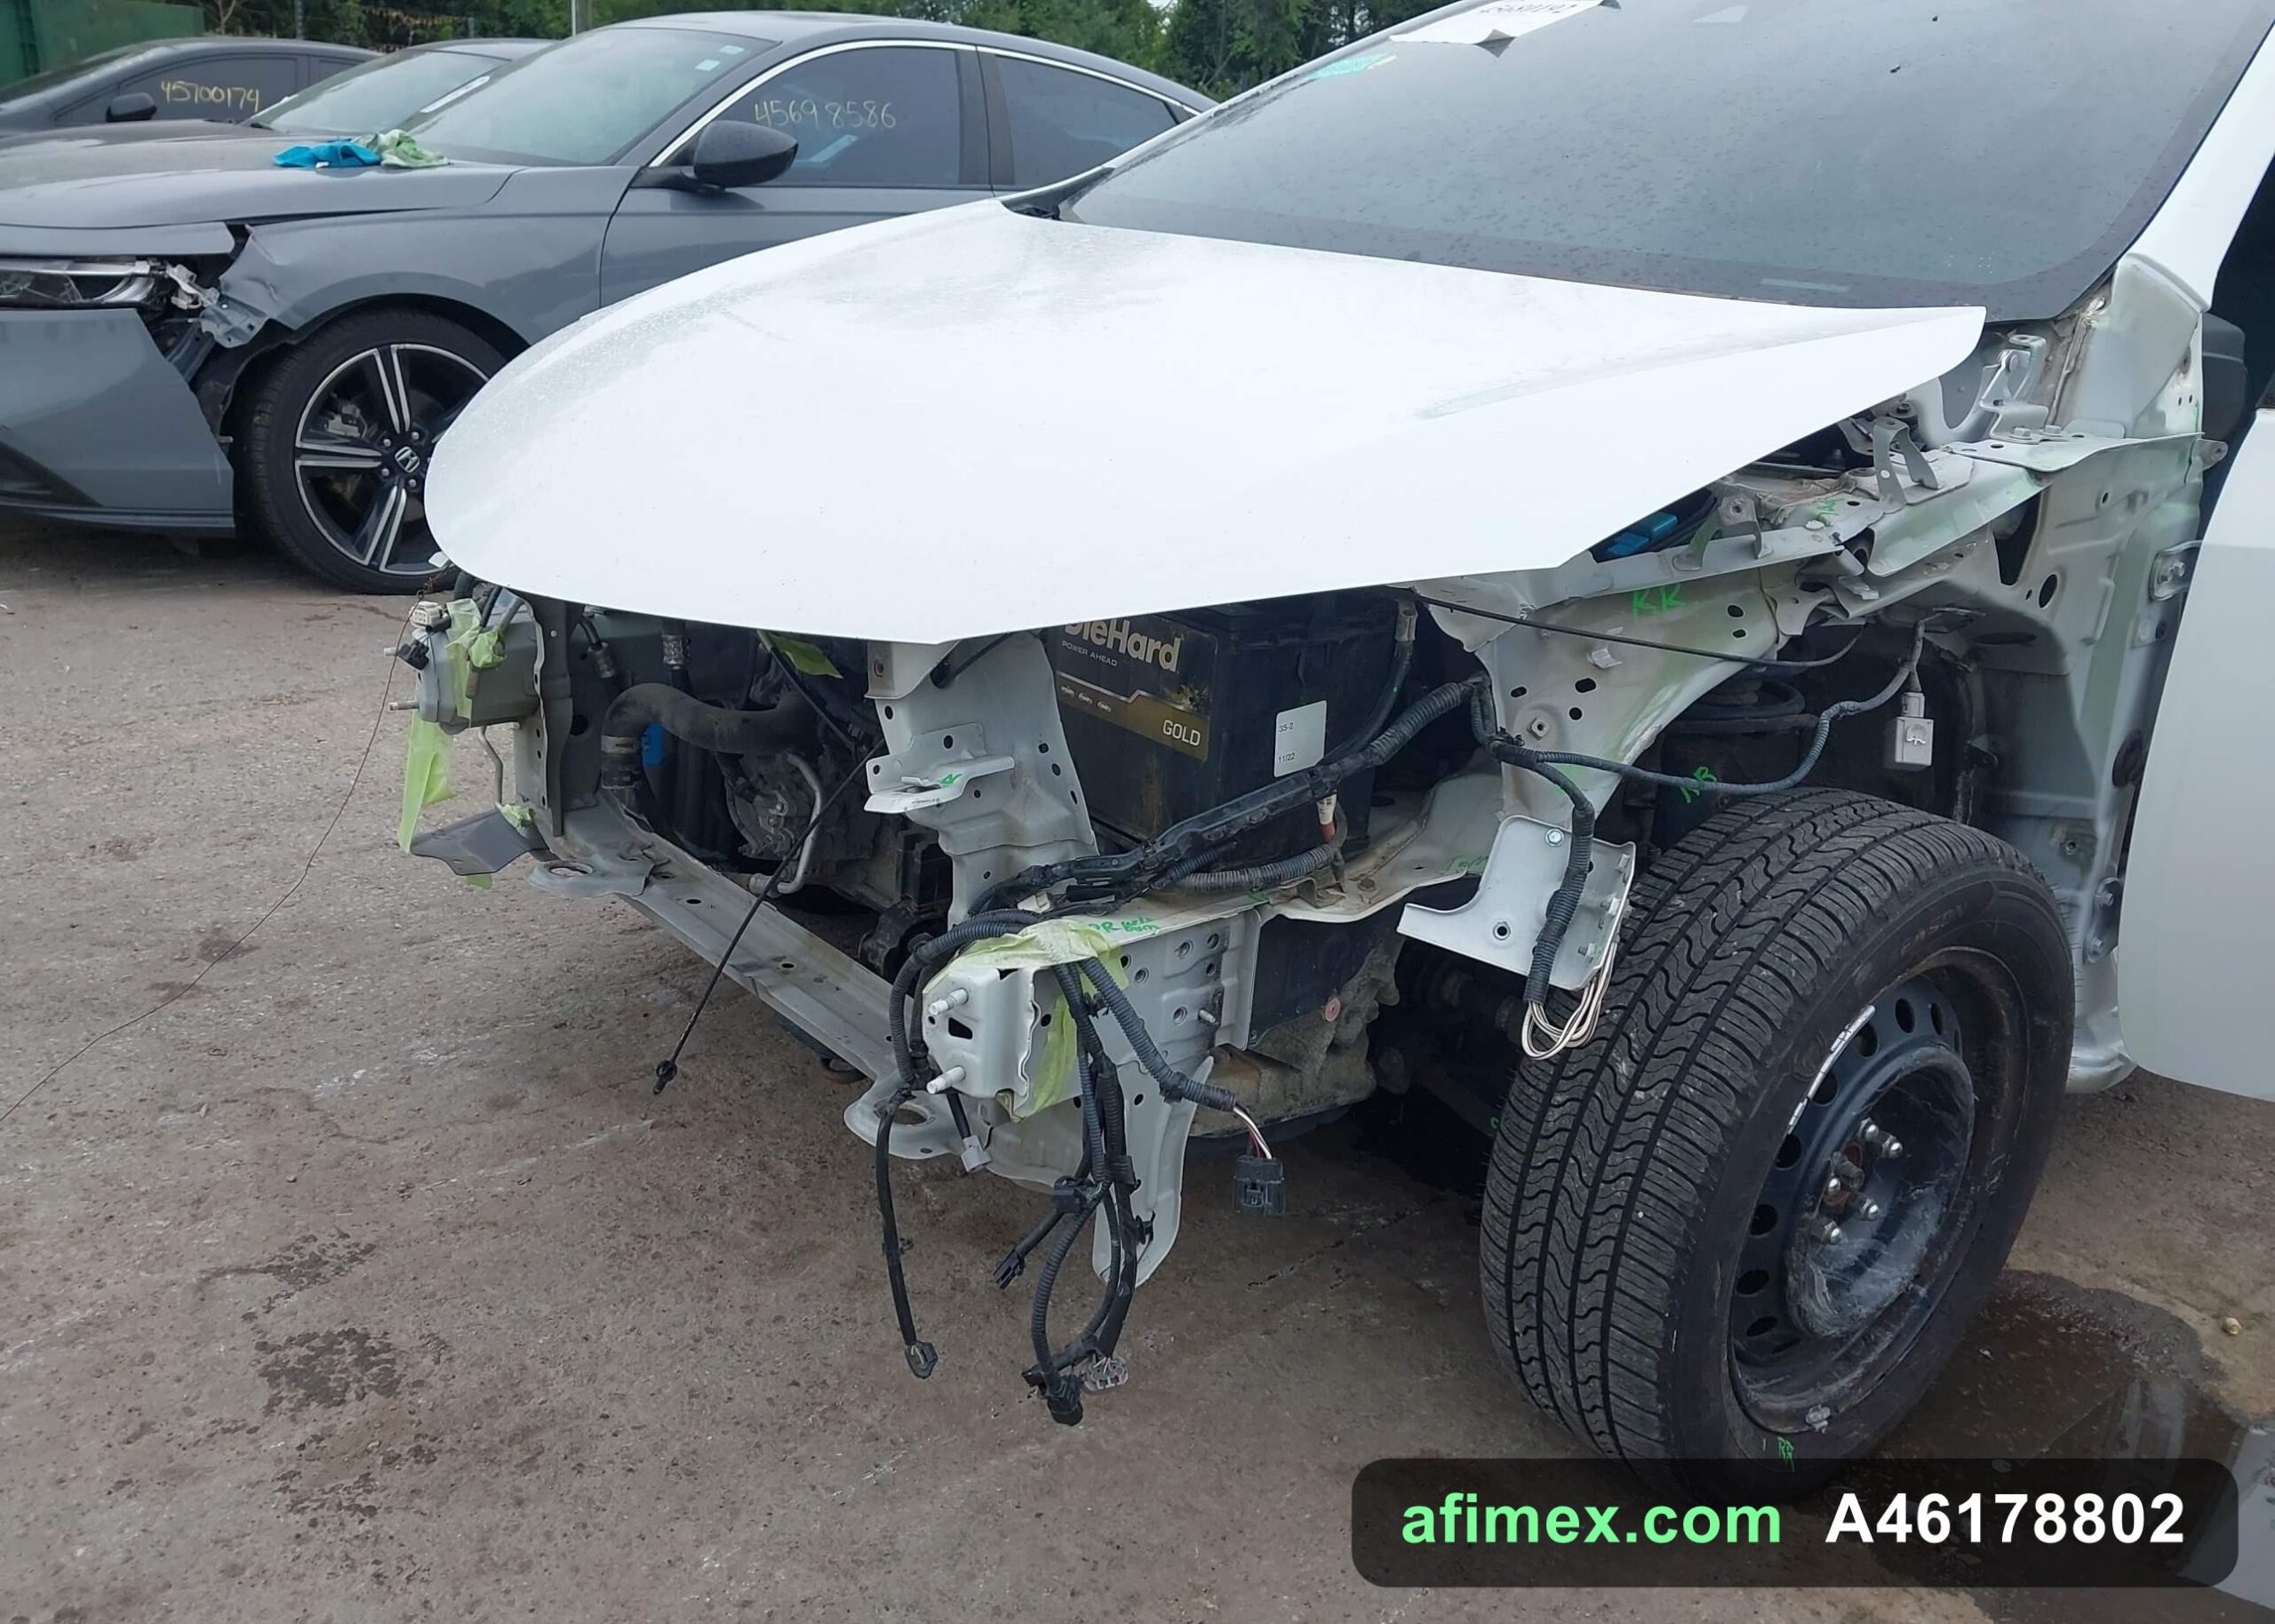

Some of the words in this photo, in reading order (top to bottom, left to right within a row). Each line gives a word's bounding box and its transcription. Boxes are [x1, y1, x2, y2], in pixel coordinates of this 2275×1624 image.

[161, 80, 259, 113] 45700174
[1062, 640, 1088, 656] POWER
[1090, 650, 1117, 667] AHEAD
[1162, 719, 1201, 746] GOLD
